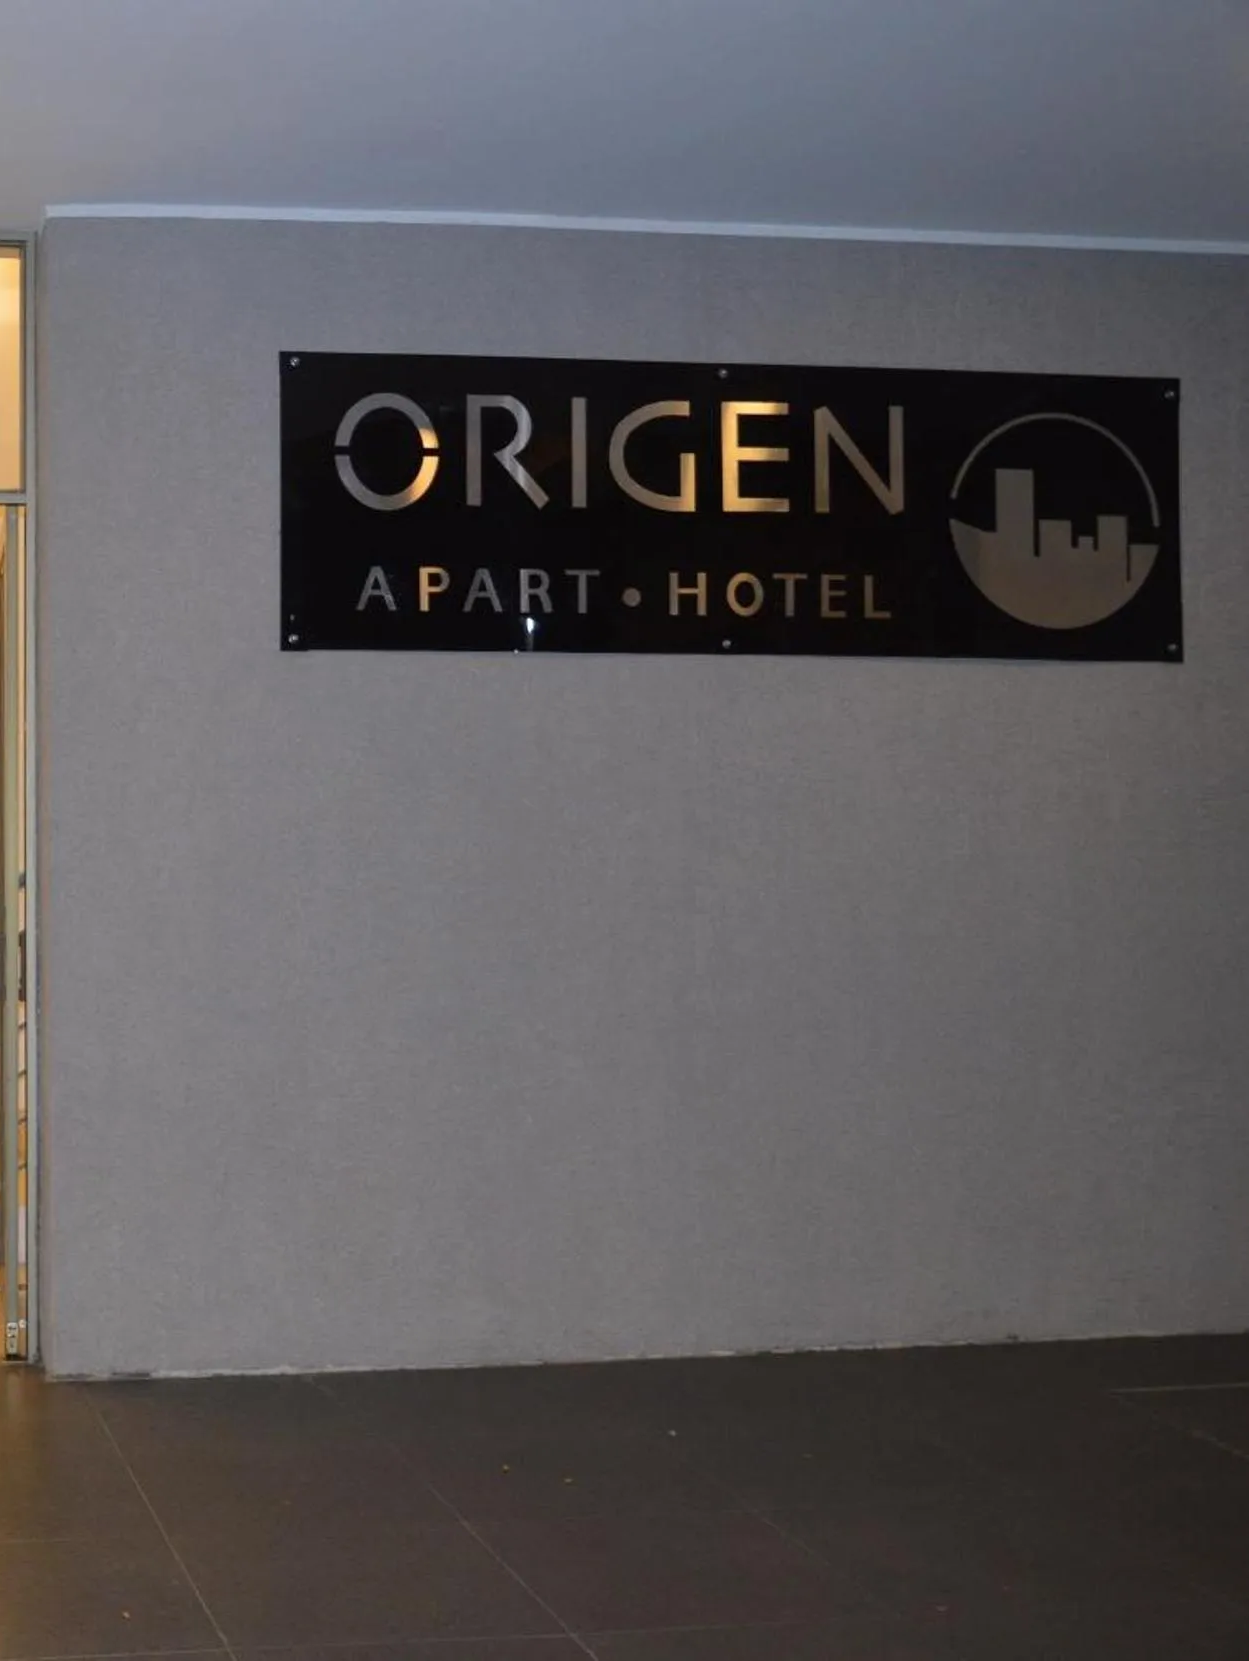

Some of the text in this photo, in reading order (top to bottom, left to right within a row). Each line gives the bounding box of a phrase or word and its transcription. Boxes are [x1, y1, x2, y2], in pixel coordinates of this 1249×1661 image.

[334, 391, 906, 514] ORIGEN
[356, 565, 893, 620] APART HOTEL
